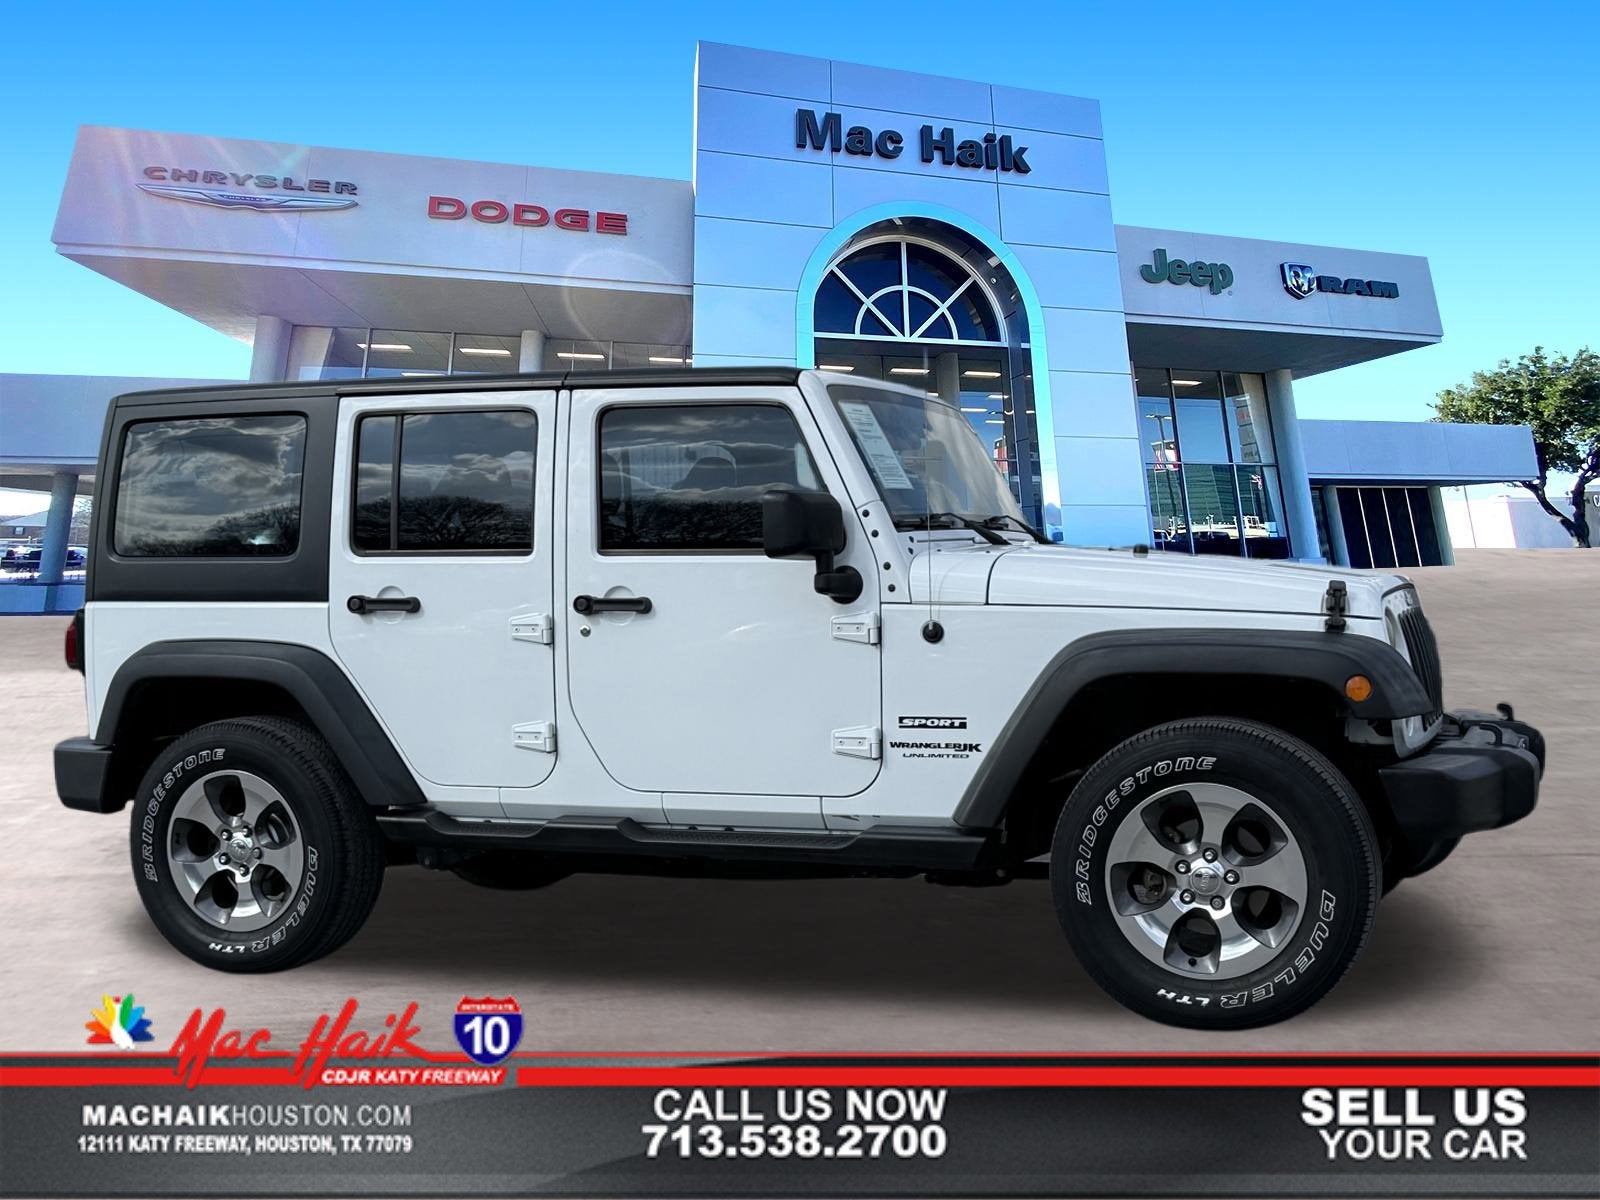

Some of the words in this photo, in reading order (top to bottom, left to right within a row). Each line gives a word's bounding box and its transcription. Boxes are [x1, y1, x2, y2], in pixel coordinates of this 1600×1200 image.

[796, 108, 904, 160] Mac
[919, 124, 1032, 174] Haik
[143, 166, 359, 196] CHRYSLER
[428, 196, 628, 236] DODGE
[1140, 248, 1234, 296] Jeep
[1316, 275, 1400, 299] RAM
[900, 718, 962, 728] SPORT
[141, 748, 226, 883] BRIDGESTONE
[1075, 755, 1217, 905] BRIDGESTONE
[251, 844, 319, 952] DUELER
[1220, 889, 1336, 1008] DUELER
